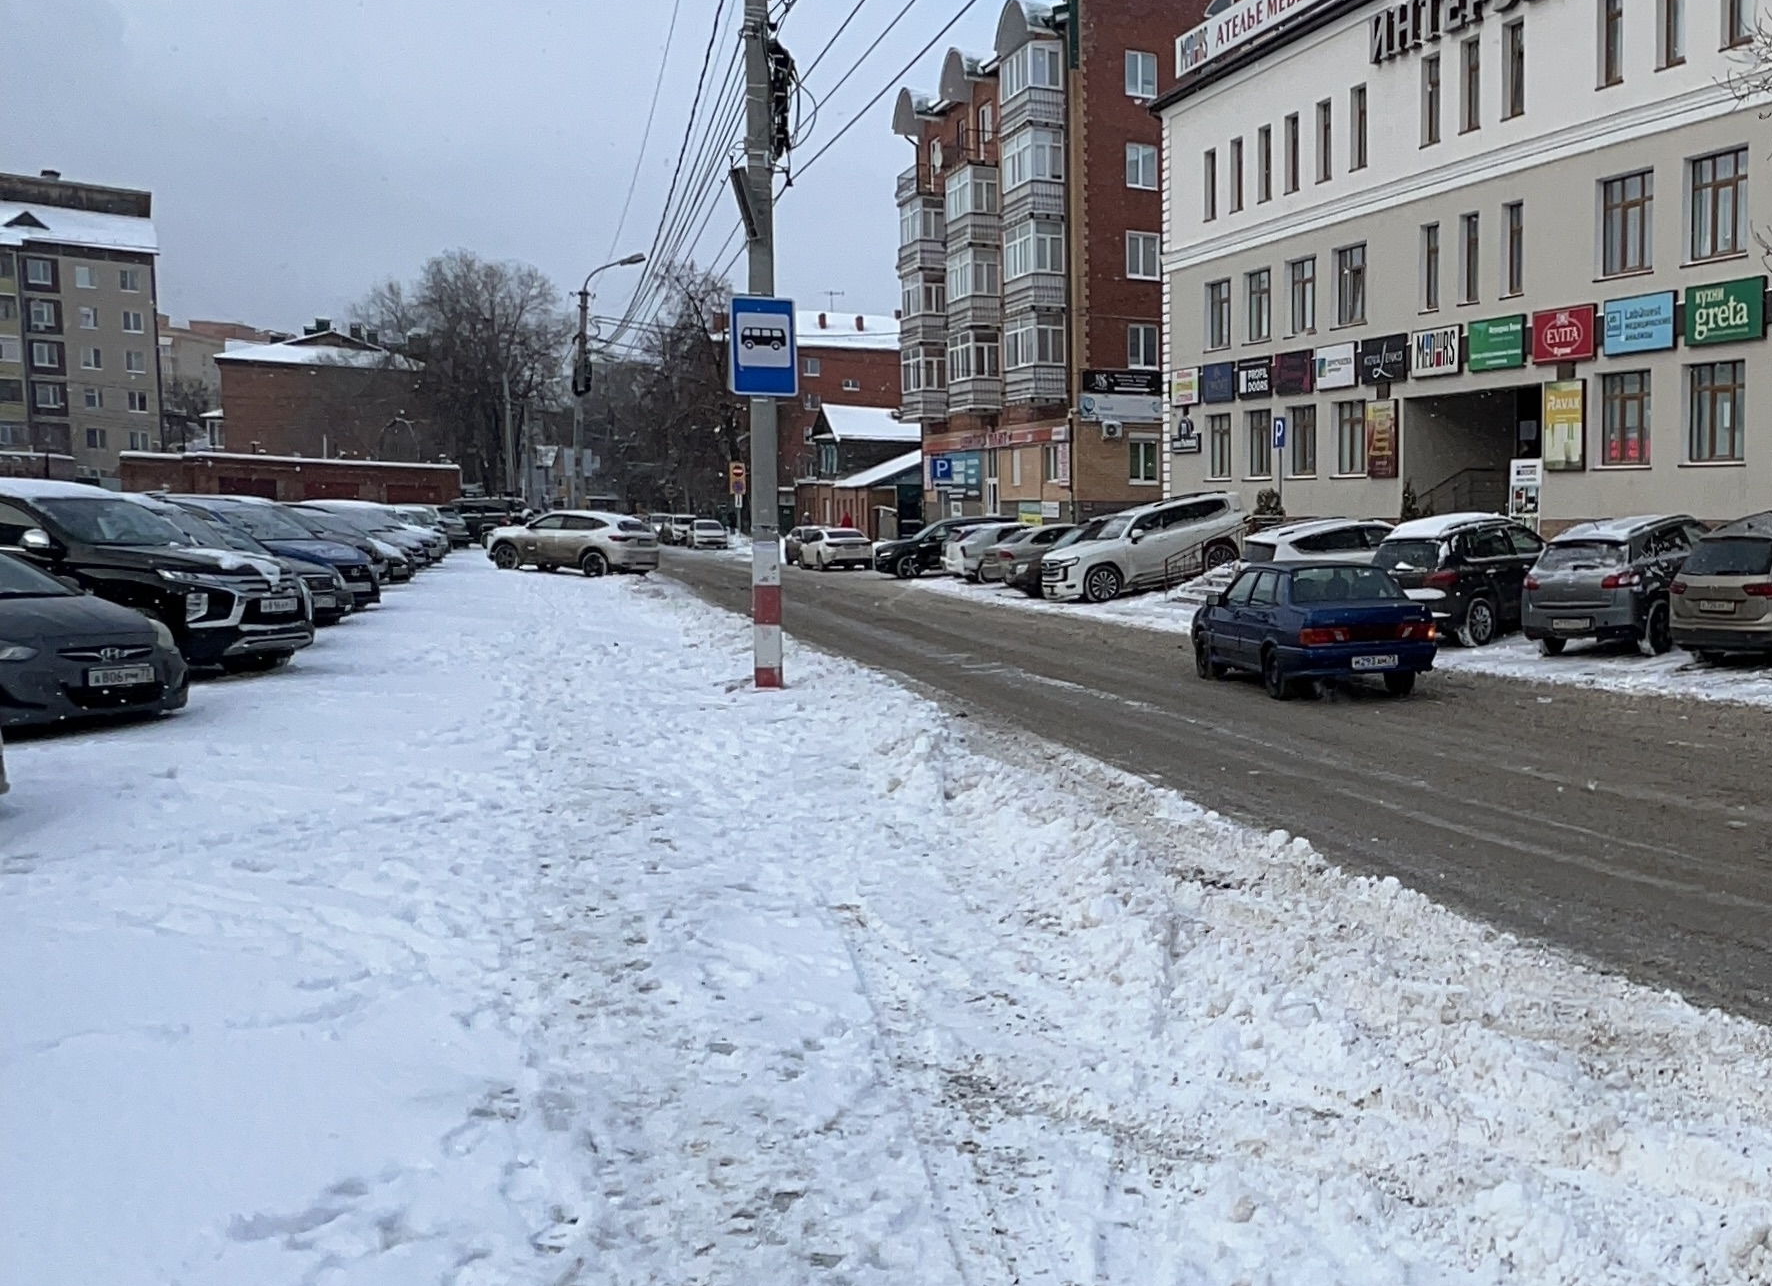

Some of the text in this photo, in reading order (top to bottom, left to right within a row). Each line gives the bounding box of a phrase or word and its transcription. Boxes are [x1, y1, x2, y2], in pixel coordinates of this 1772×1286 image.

[1216, 0, 1263, 48] АТЕЛЬЕ
[1695, 300, 1749, 339] greta
[1547, 327, 1579, 344] EVITA
[1248, 367, 1268, 380] PROFIL
[1248, 380, 1268, 393] DOORS
